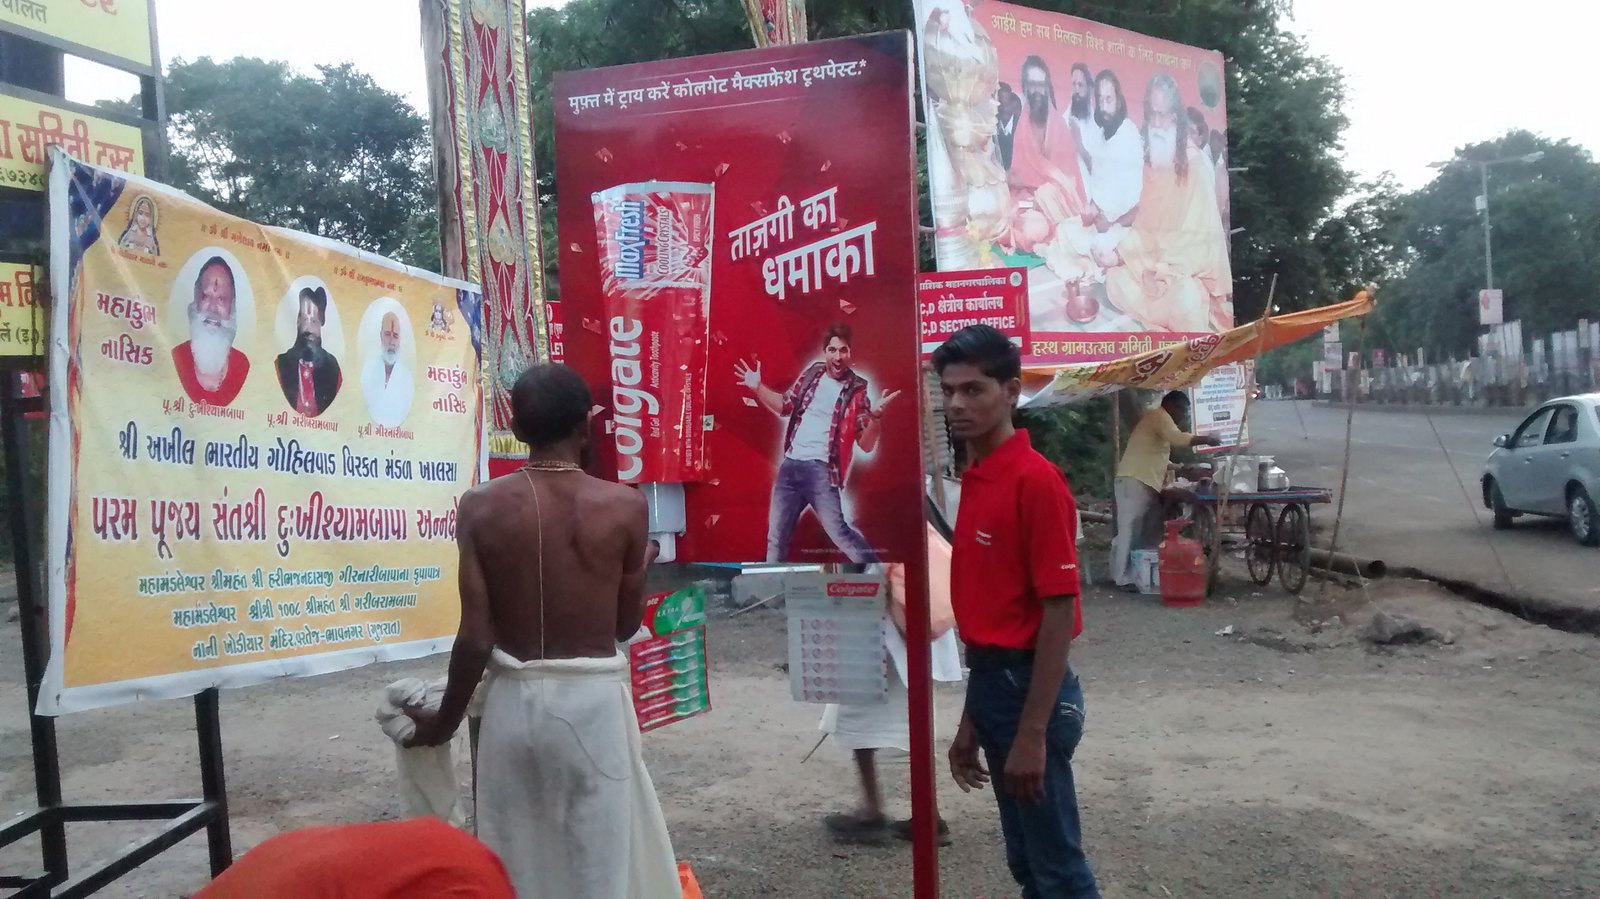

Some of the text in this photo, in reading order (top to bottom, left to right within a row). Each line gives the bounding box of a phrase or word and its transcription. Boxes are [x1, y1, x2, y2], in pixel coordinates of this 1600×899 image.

[1020, 21, 1033, 38] हम
[603, 87, 616, 106] में
[618, 88, 645, 109] ट्राय
[647, 81, 671, 101] करें
[672, 75, 728, 98] कोलगेट
[731, 71, 799, 91] मैक्सफ्रेश
[728, 186, 838, 261] ताज़गी का
[762, 221, 877, 301] धमाका
[965, 291, 1004, 311] कार्यालय
[922, 321, 937, 336] C,D
[980, 316, 1015, 331] OFFICE
[101, 334, 153, 364] નાસિક
[1031, 341, 1058, 357] हस्थ
[610, 316, 659, 481] Colgate
[119, 421, 138, 460] શ્રી
[147, 427, 195, 465] અખીલ
[204, 434, 259, 470] ભારતીય
[267, 437, 336, 475] ગોહિલવાડ
[385, 449, 413, 480] મંડળ
[418, 461, 458, 482] ખાલસા
[92, 497, 138, 541] પરમ
[212, 486, 267, 541] સંતશ્રી
[416, 496, 458, 542] અન્નક્ષે
[211, 568, 248, 590] શ્રીમહંત
[251, 568, 264, 588] શ્રી
[278, 602, 301, 617] ૧૦૦૮
[305, 593, 336, 615] શ્રીમહંત
[339, 593, 351, 611] શ્રી
[193, 635, 219, 658] નાની
